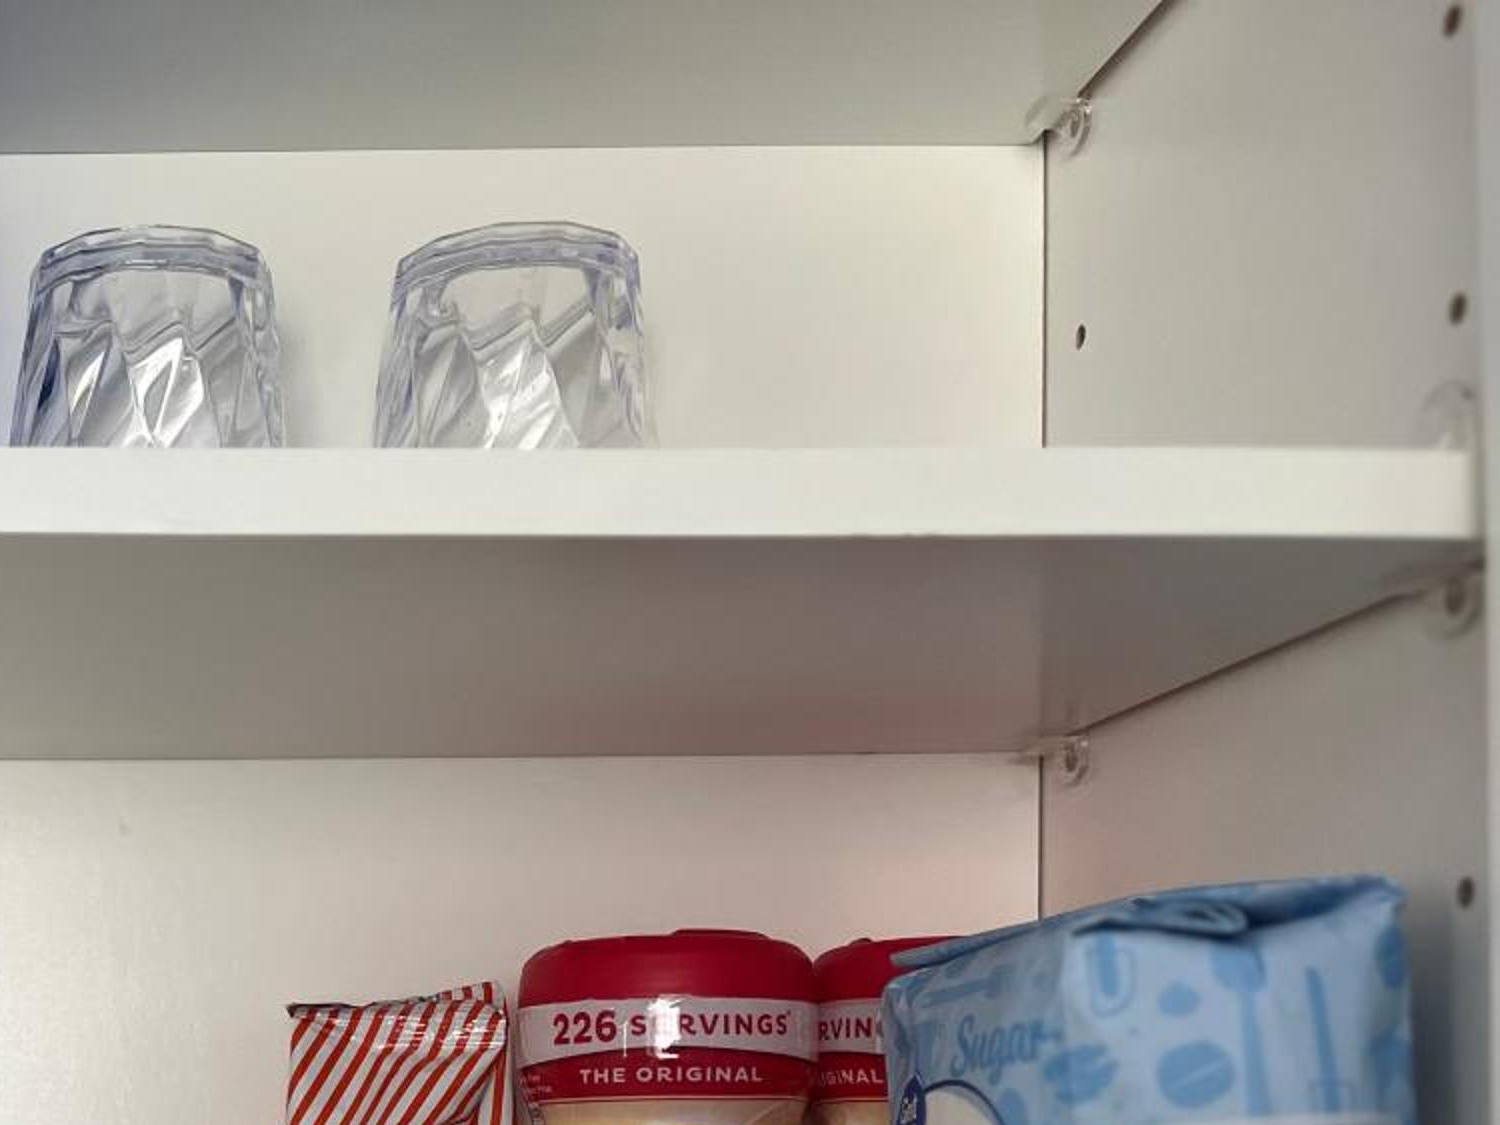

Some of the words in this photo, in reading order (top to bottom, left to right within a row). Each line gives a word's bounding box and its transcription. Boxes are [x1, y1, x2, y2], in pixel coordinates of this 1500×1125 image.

[553, 1010, 617, 1045] 226
[630, 1013, 788, 1036] SRVINGS
[580, 1067, 626, 1084] THE
[636, 1066, 764, 1083] ORIGINAL
